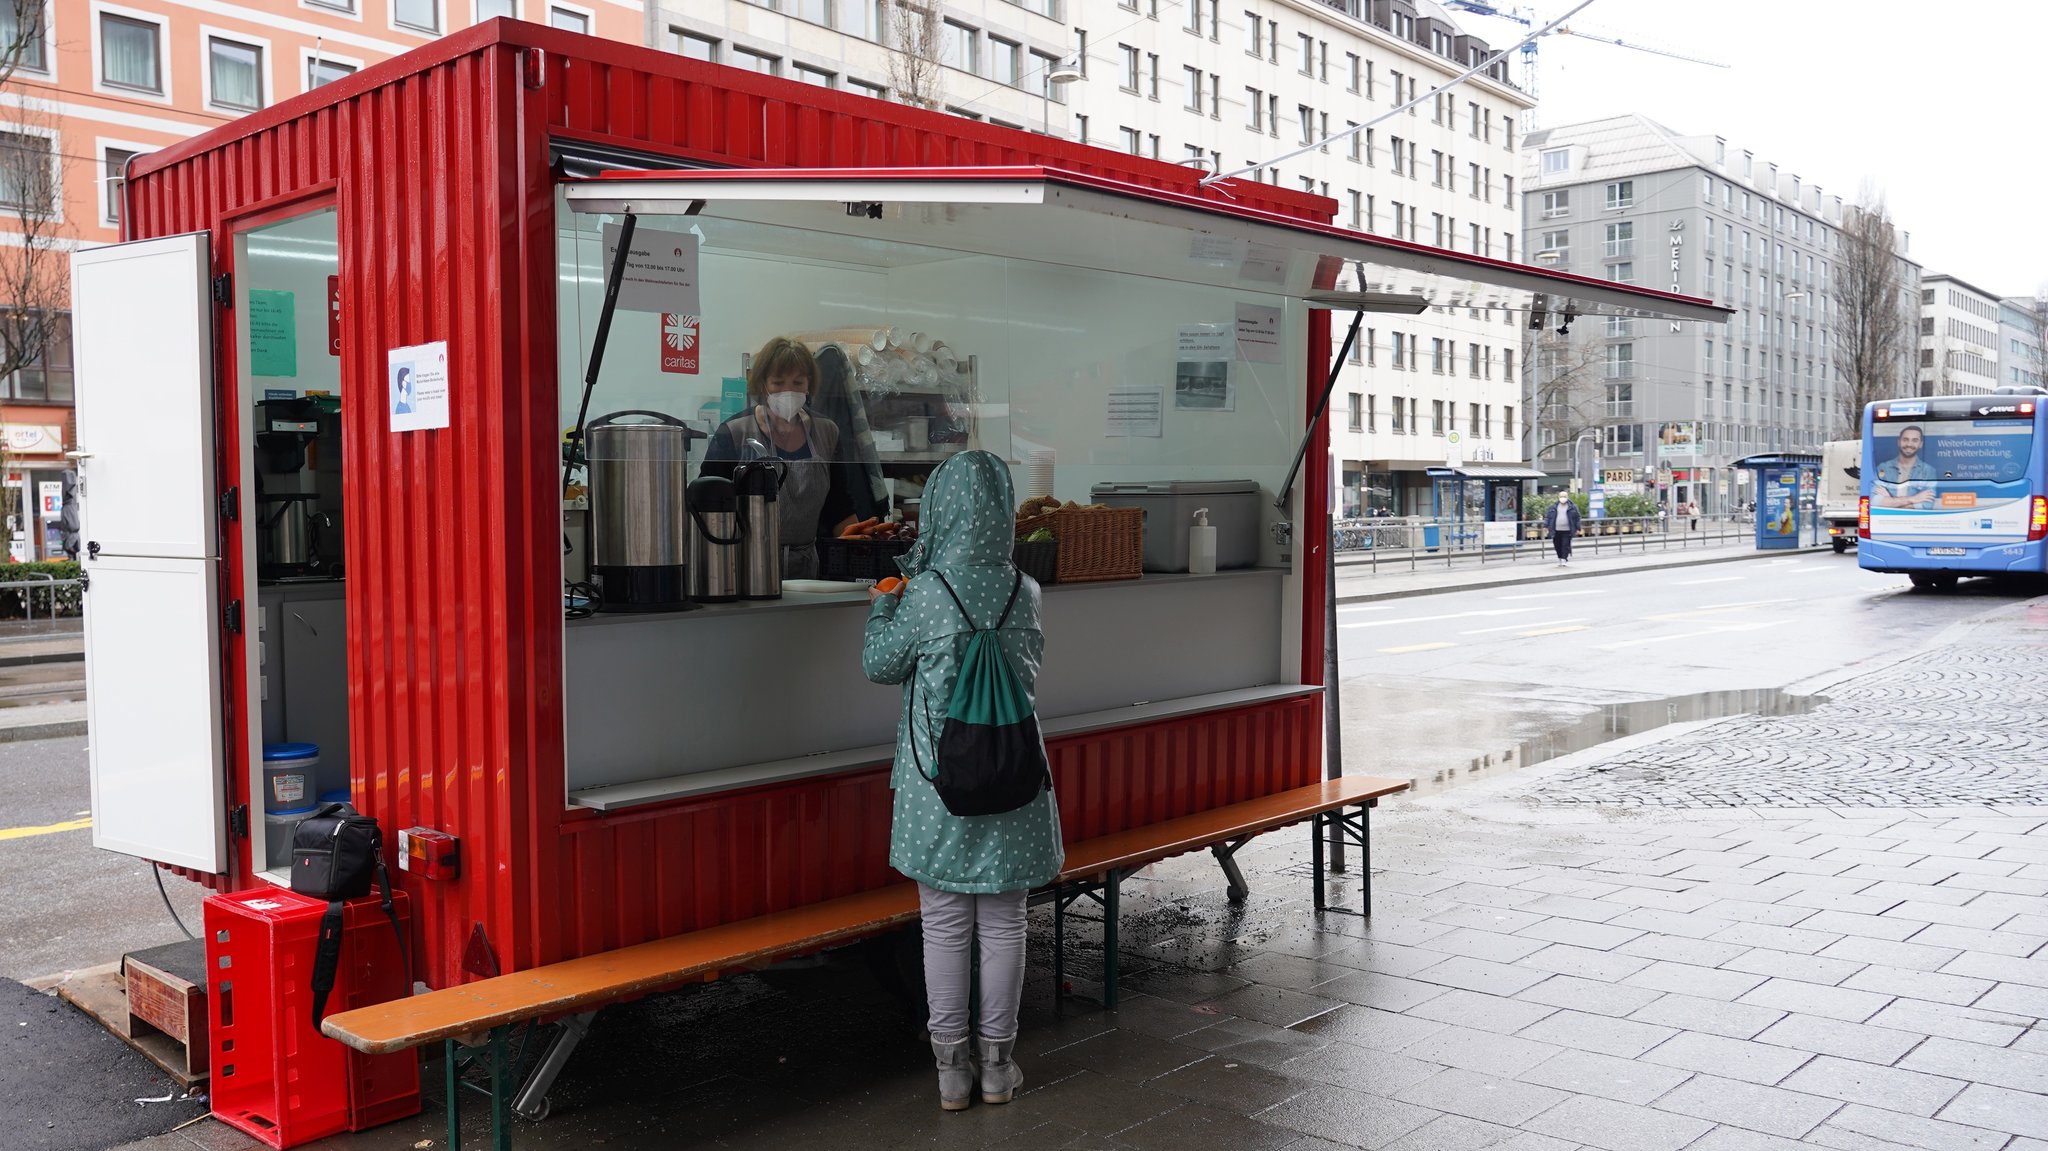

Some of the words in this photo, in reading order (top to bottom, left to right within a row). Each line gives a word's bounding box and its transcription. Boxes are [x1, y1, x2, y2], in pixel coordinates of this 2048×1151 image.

[1670, 235, 1682, 332] MERIDN
[664, 356, 696, 368] caritas
[1938, 439, 2000, 447] Weiterkommen
[1953, 448, 2013, 459] Weiterbildung.
[1606, 472, 1632, 482] PARIS
